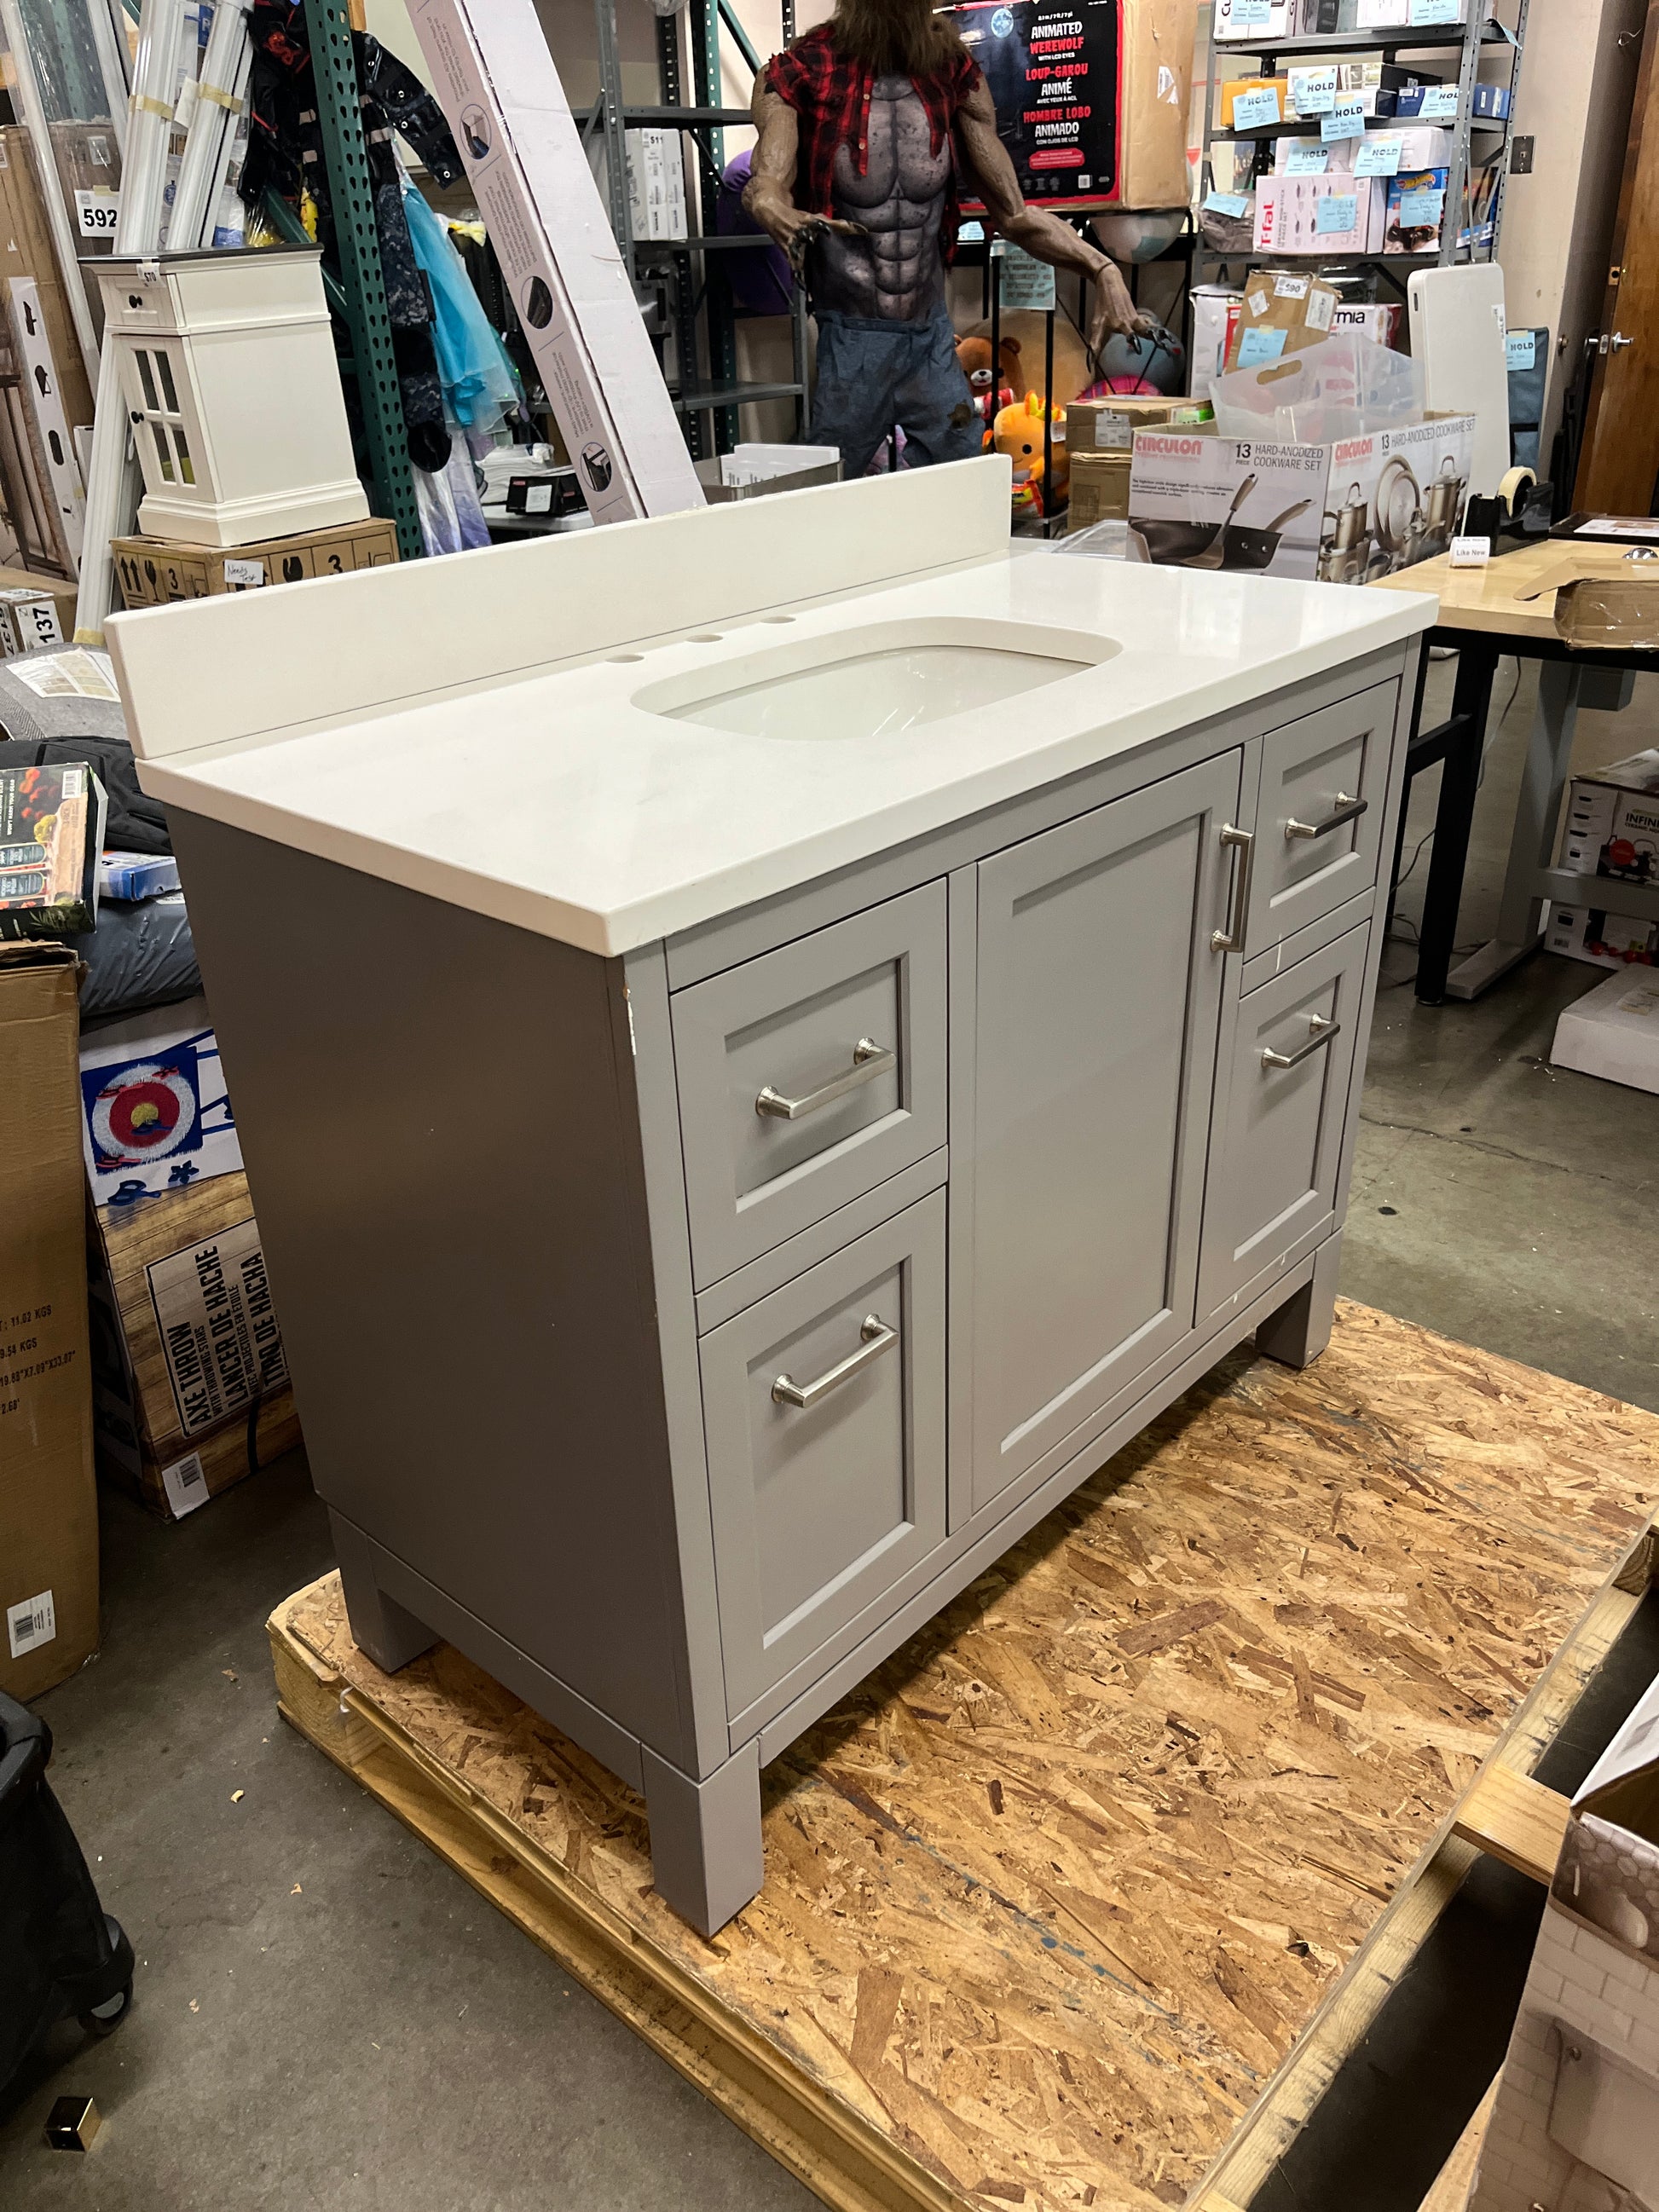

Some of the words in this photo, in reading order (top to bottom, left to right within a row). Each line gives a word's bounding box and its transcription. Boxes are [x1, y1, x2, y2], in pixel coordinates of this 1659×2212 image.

[1031, 21, 1083, 39] ANIMATED
[1030, 37, 1084, 55] WEREWOLF
[1026, 62, 1089, 81] LOUP-GAROU
[1041, 77, 1072, 96] ANIMÉ
[1307, 82, 1334, 93] HOLD
[1248, 94, 1274, 106] HOLD
[1023, 108, 1063, 124] HOMBRE
[1066, 106, 1091, 119] LOBO
[1335, 106, 1363, 118] HOLD
[1035, 121, 1079, 138] ANIMADO
[1302, 149, 1327, 159] HOLD
[1372, 148, 1398, 157] HOLD
[84, 208, 118, 228] 592
[1261, 199, 1275, 248] T-fal
[1510, 342, 1534, 351] HOLD
[1135, 436, 1203, 456] CIRCULON
[1236, 444, 1251, 459] 13
[1255, 444, 1324, 459] HARD-ANODIZED
[1335, 438, 1373, 463] CIRCULON
[1382, 435, 1390, 449] 13
[1391, 428, 1435, 448] HARD-ANODIZED
[1436, 420, 1465, 439] COOKWARE
[1253, 456, 1301, 470] COOKWARE
[1304, 461, 1321, 471] SET
[169, 568, 178, 590] 3
[32, 607, 55, 644] 137
[195, 1245, 228, 1313] HACHE
[240, 1251, 271, 1319] HACHA
[35, 1305, 52, 1320] KGS
[209, 1308, 233, 1338] DE
[234, 1310, 244, 1325] EN
[194, 1325, 205, 1353] STARS
[253, 1314, 276, 1344] DE
[20, 1337, 38, 1352] KGS
[236, 1323, 255, 1376] PROJECTILES
[167, 1321, 201, 1392] THROW
[257, 1339, 285, 1387] TIRO
[200, 1350, 217, 1396] THROWING
[215, 1334, 248, 1407] LANCER
[183, 1387, 211, 1427] AXE
[211, 1393, 223, 1417] WITH
